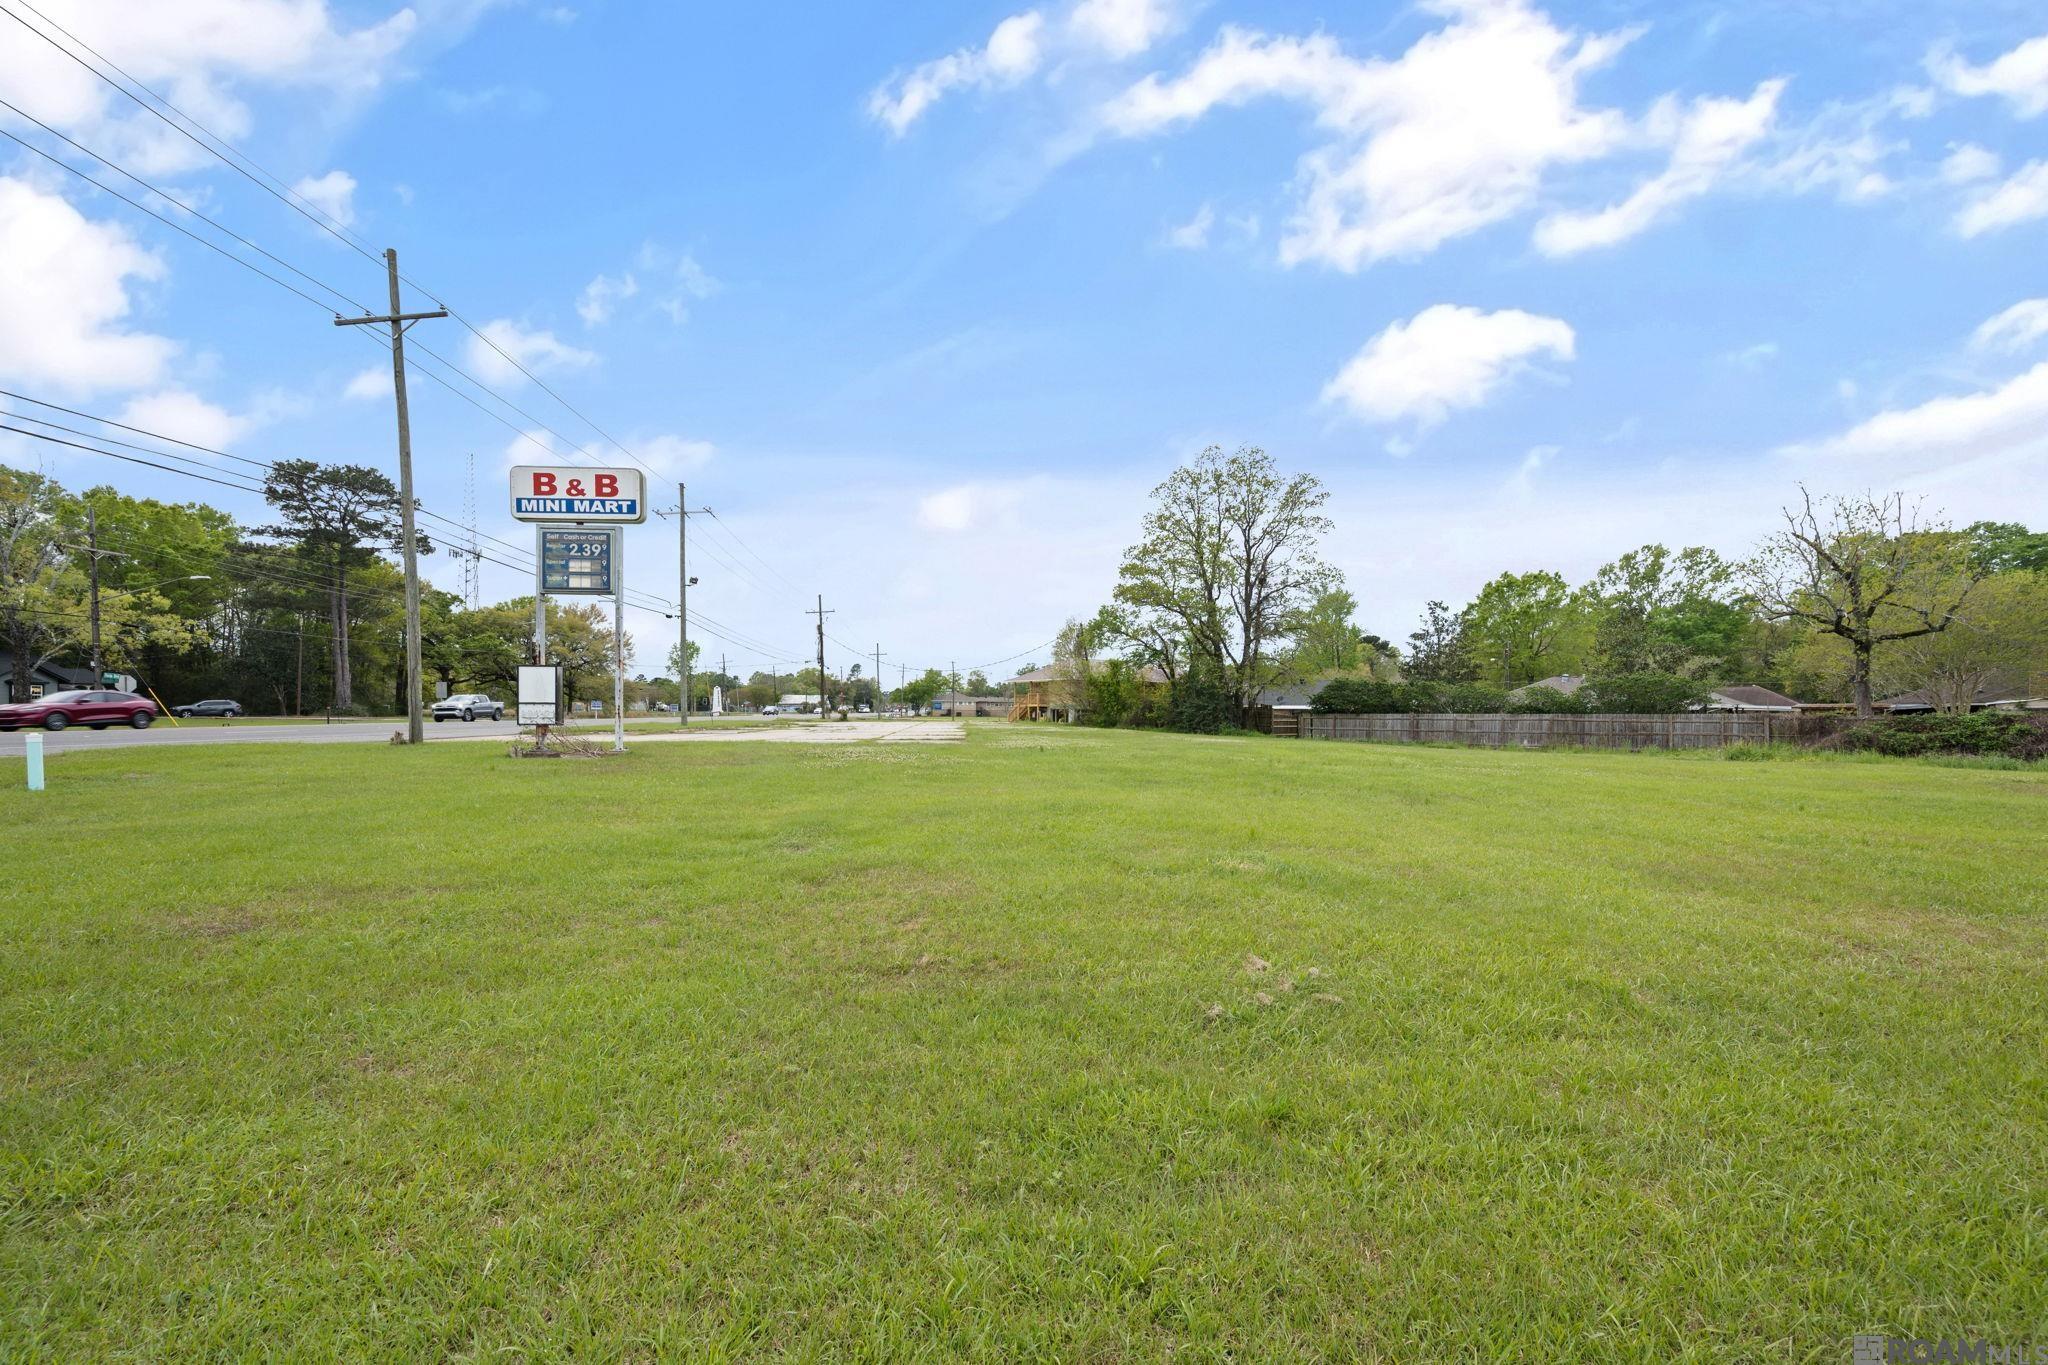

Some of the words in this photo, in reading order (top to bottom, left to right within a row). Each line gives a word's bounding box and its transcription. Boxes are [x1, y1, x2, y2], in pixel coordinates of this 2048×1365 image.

[532, 472, 558, 496] B
[565, 478, 587, 497] &
[594, 473, 619, 498] B
[521, 499, 567, 512] MINI
[573, 500, 632, 513] MART
